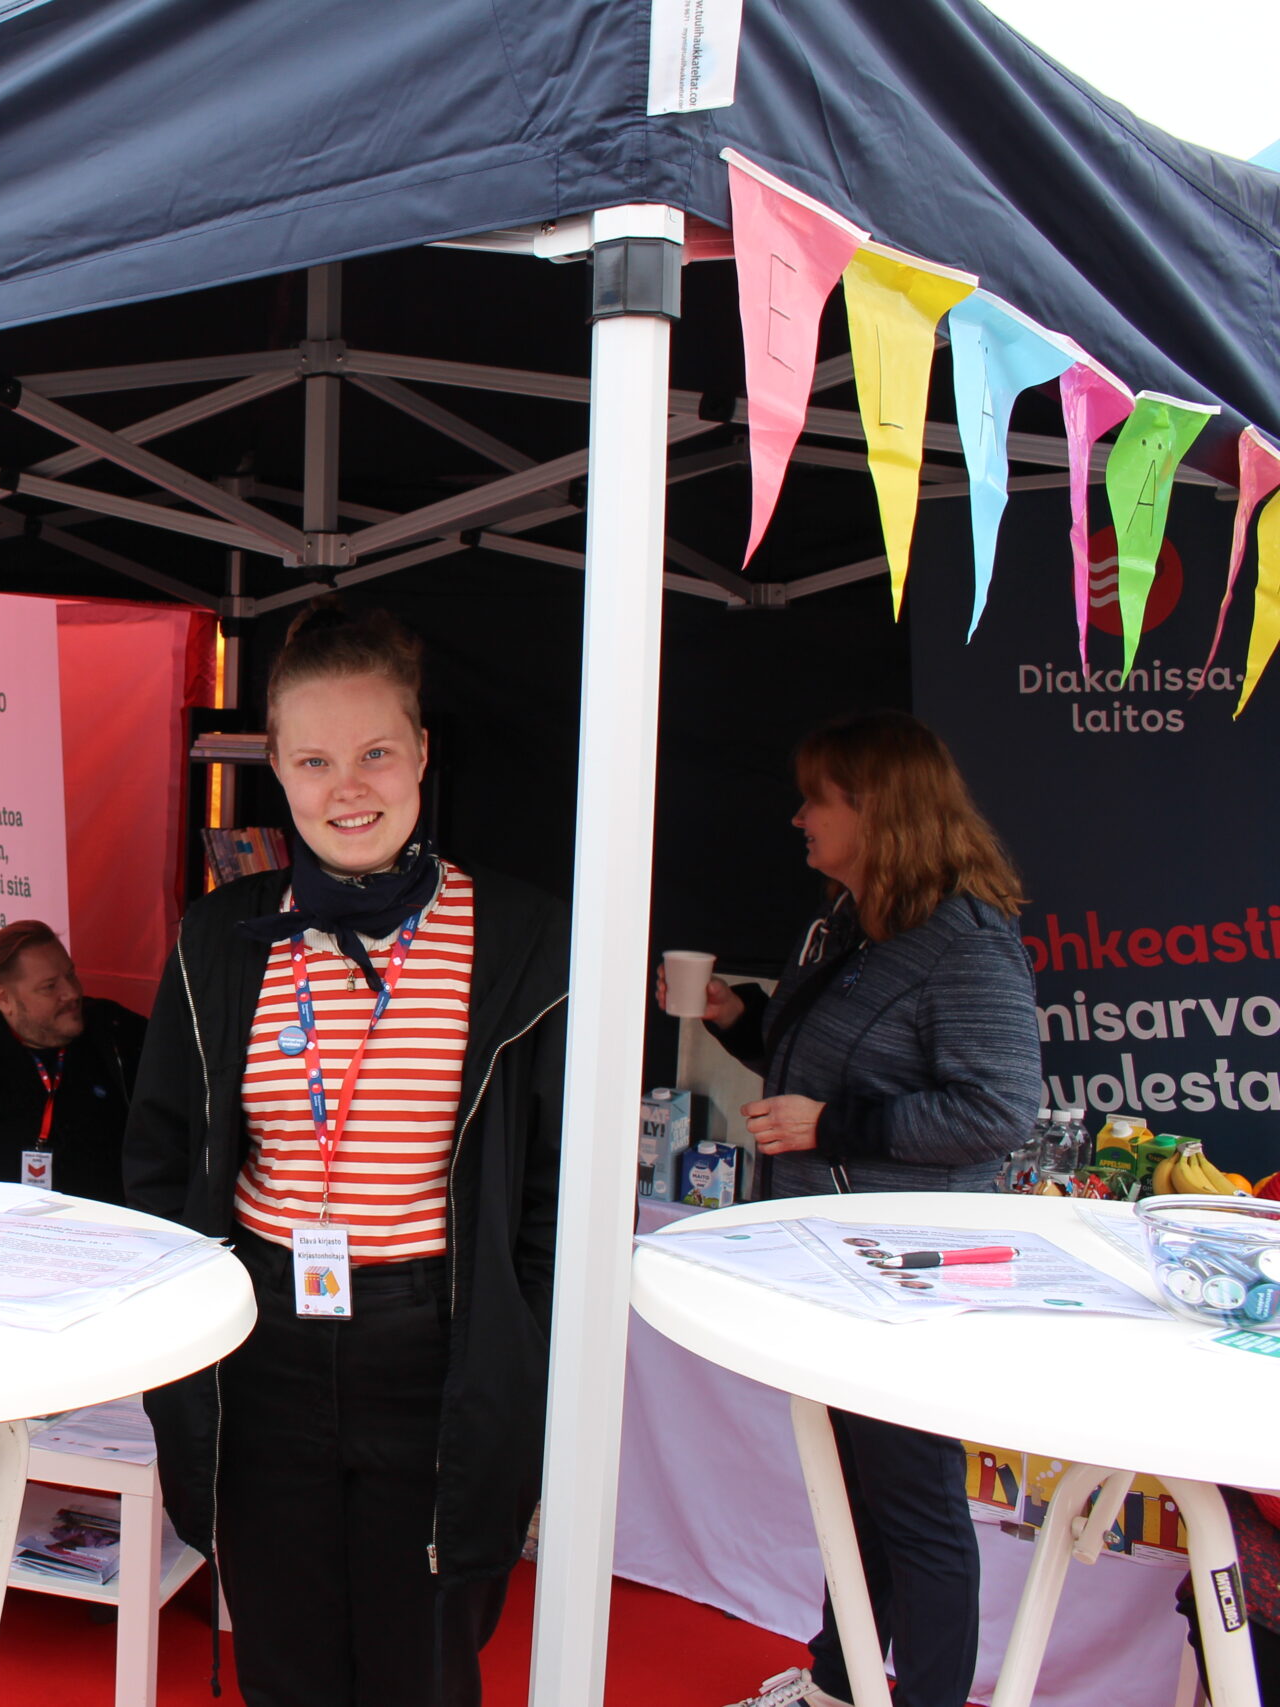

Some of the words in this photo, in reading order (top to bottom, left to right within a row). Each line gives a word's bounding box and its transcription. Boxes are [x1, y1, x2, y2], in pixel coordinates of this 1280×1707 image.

[1072, 702, 1186, 733] laitos
[7, 876, 32, 898] sitä
[1036, 990, 1280, 1042] misarvo
[1041, 1052, 1280, 1113] uolesta
[643, 1121, 665, 1138] LY!
